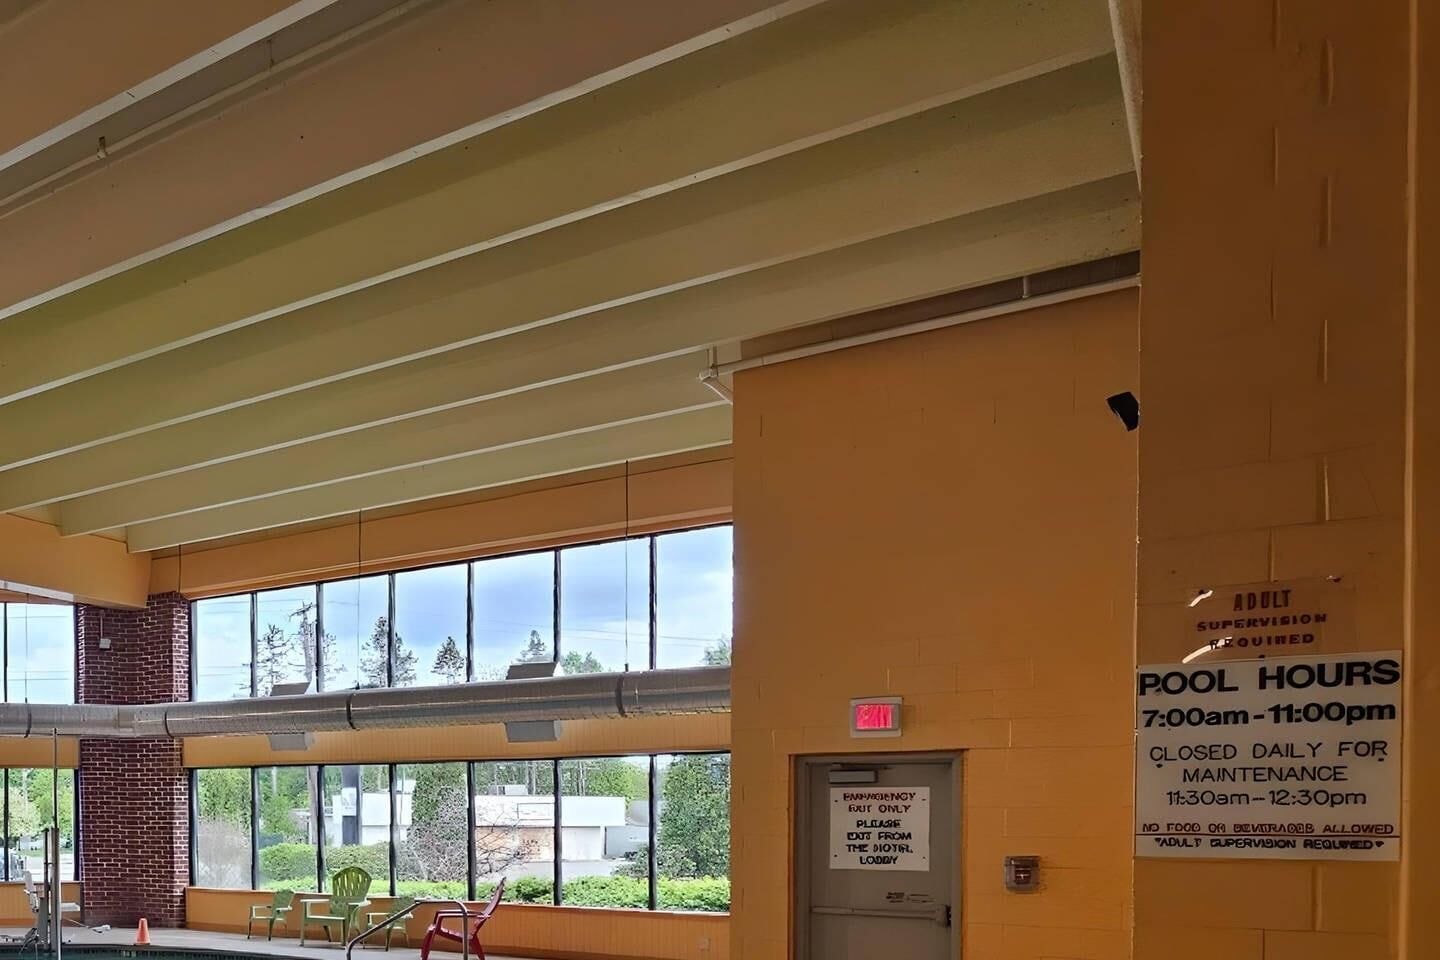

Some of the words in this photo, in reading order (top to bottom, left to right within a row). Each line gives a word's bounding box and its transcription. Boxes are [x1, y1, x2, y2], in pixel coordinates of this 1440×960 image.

[1233, 589, 1291, 611] ADULT
[1196, 613, 1328, 631] SUPERVISION
[1138, 669, 1239, 696] POOL
[1258, 659, 1400, 690] HOURS
[1149, 745, 1237, 761] CLOSED
[1252, 742, 1323, 760] DAILY
[1338, 740, 1388, 757] FOR
[1182, 766, 1349, 782] MAINTENANCE
[878, 804, 911, 814] ONLY
[878, 831, 912, 841] FROM
[1143, 823, 1160, 832] NO
[1166, 823, 1201, 832] FOOD
[1322, 824, 1395, 835] ALLOWED
[845, 844, 869, 853] THE
